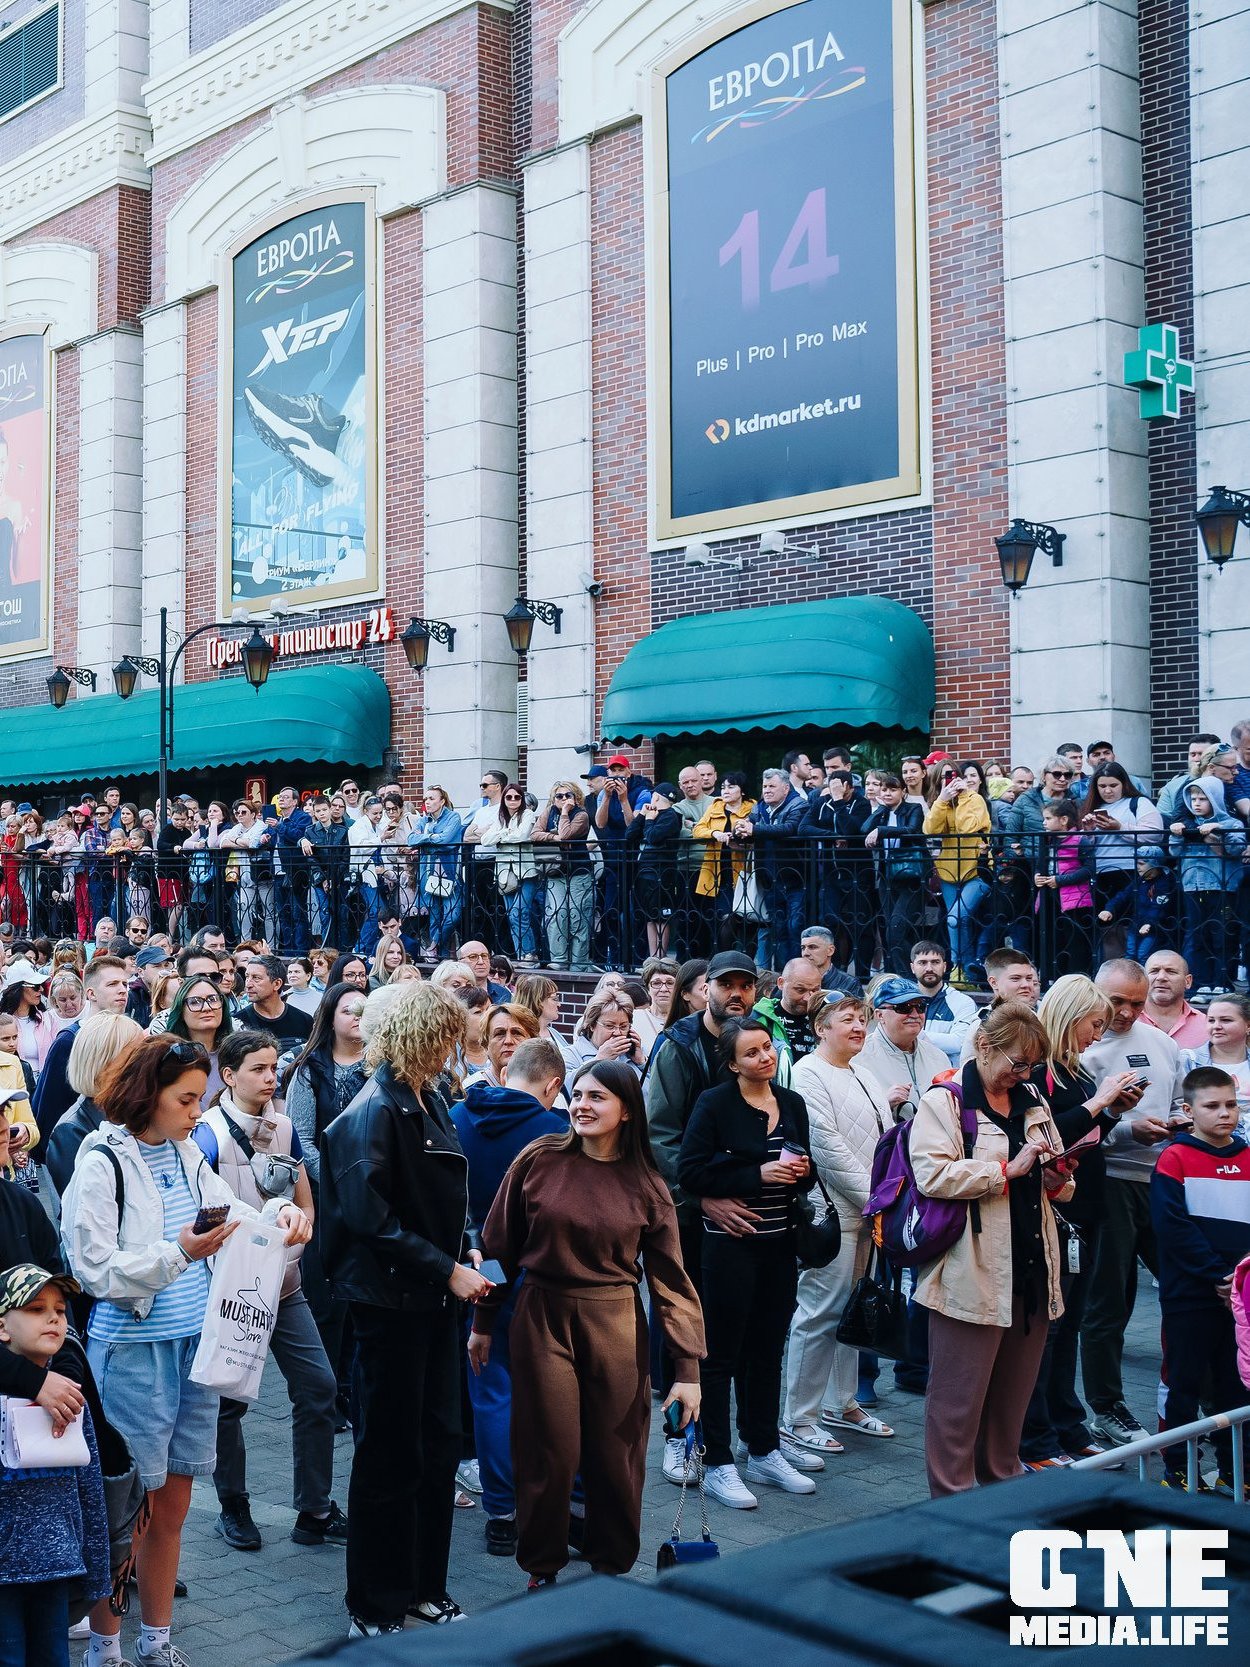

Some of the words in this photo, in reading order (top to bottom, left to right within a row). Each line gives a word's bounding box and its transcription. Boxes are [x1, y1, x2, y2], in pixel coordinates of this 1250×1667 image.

[707, 31, 845, 112] ЕВРОПА
[255, 219, 341, 278] ЕВРОПА
[719, 186, 839, 313] 14
[695, 354, 729, 377] Plus
[748, 343, 775, 364] Pro
[795, 330, 824, 352] Pro
[832, 319, 868, 342] Max
[734, 393, 861, 437] kdmarket.ru
[271, 513, 299, 540] FOR
[281, 579, 288, 592] 2
[369, 607, 393, 642] 24
[1216, 1165, 1241, 1175] FILA
[219, 1298, 251, 1325] MUST
[232, 1313, 263, 1344] Store
